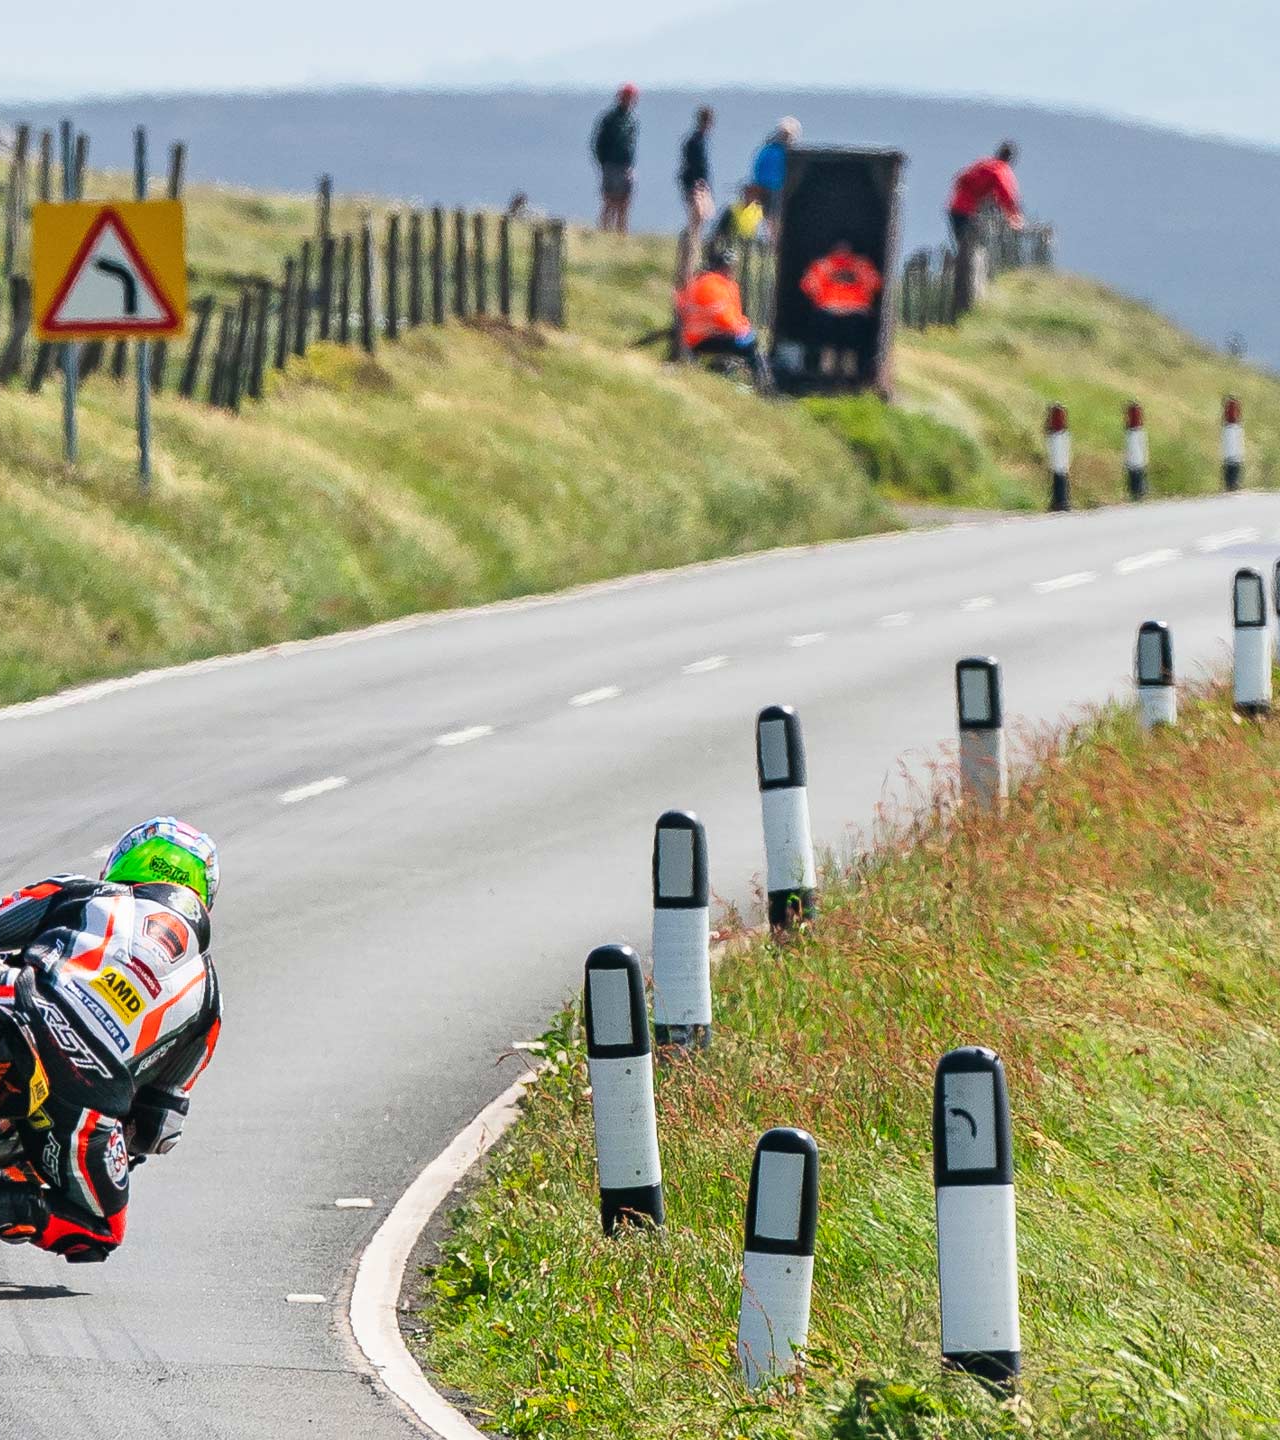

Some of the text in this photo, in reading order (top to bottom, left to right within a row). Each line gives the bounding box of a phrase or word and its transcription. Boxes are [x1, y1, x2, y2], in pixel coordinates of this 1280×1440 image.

[64, 978, 121, 1039] METZELER
[102, 971, 141, 1013] AMD
[31, 996, 114, 1079] RST
[41, 1130, 61, 1188] RST
